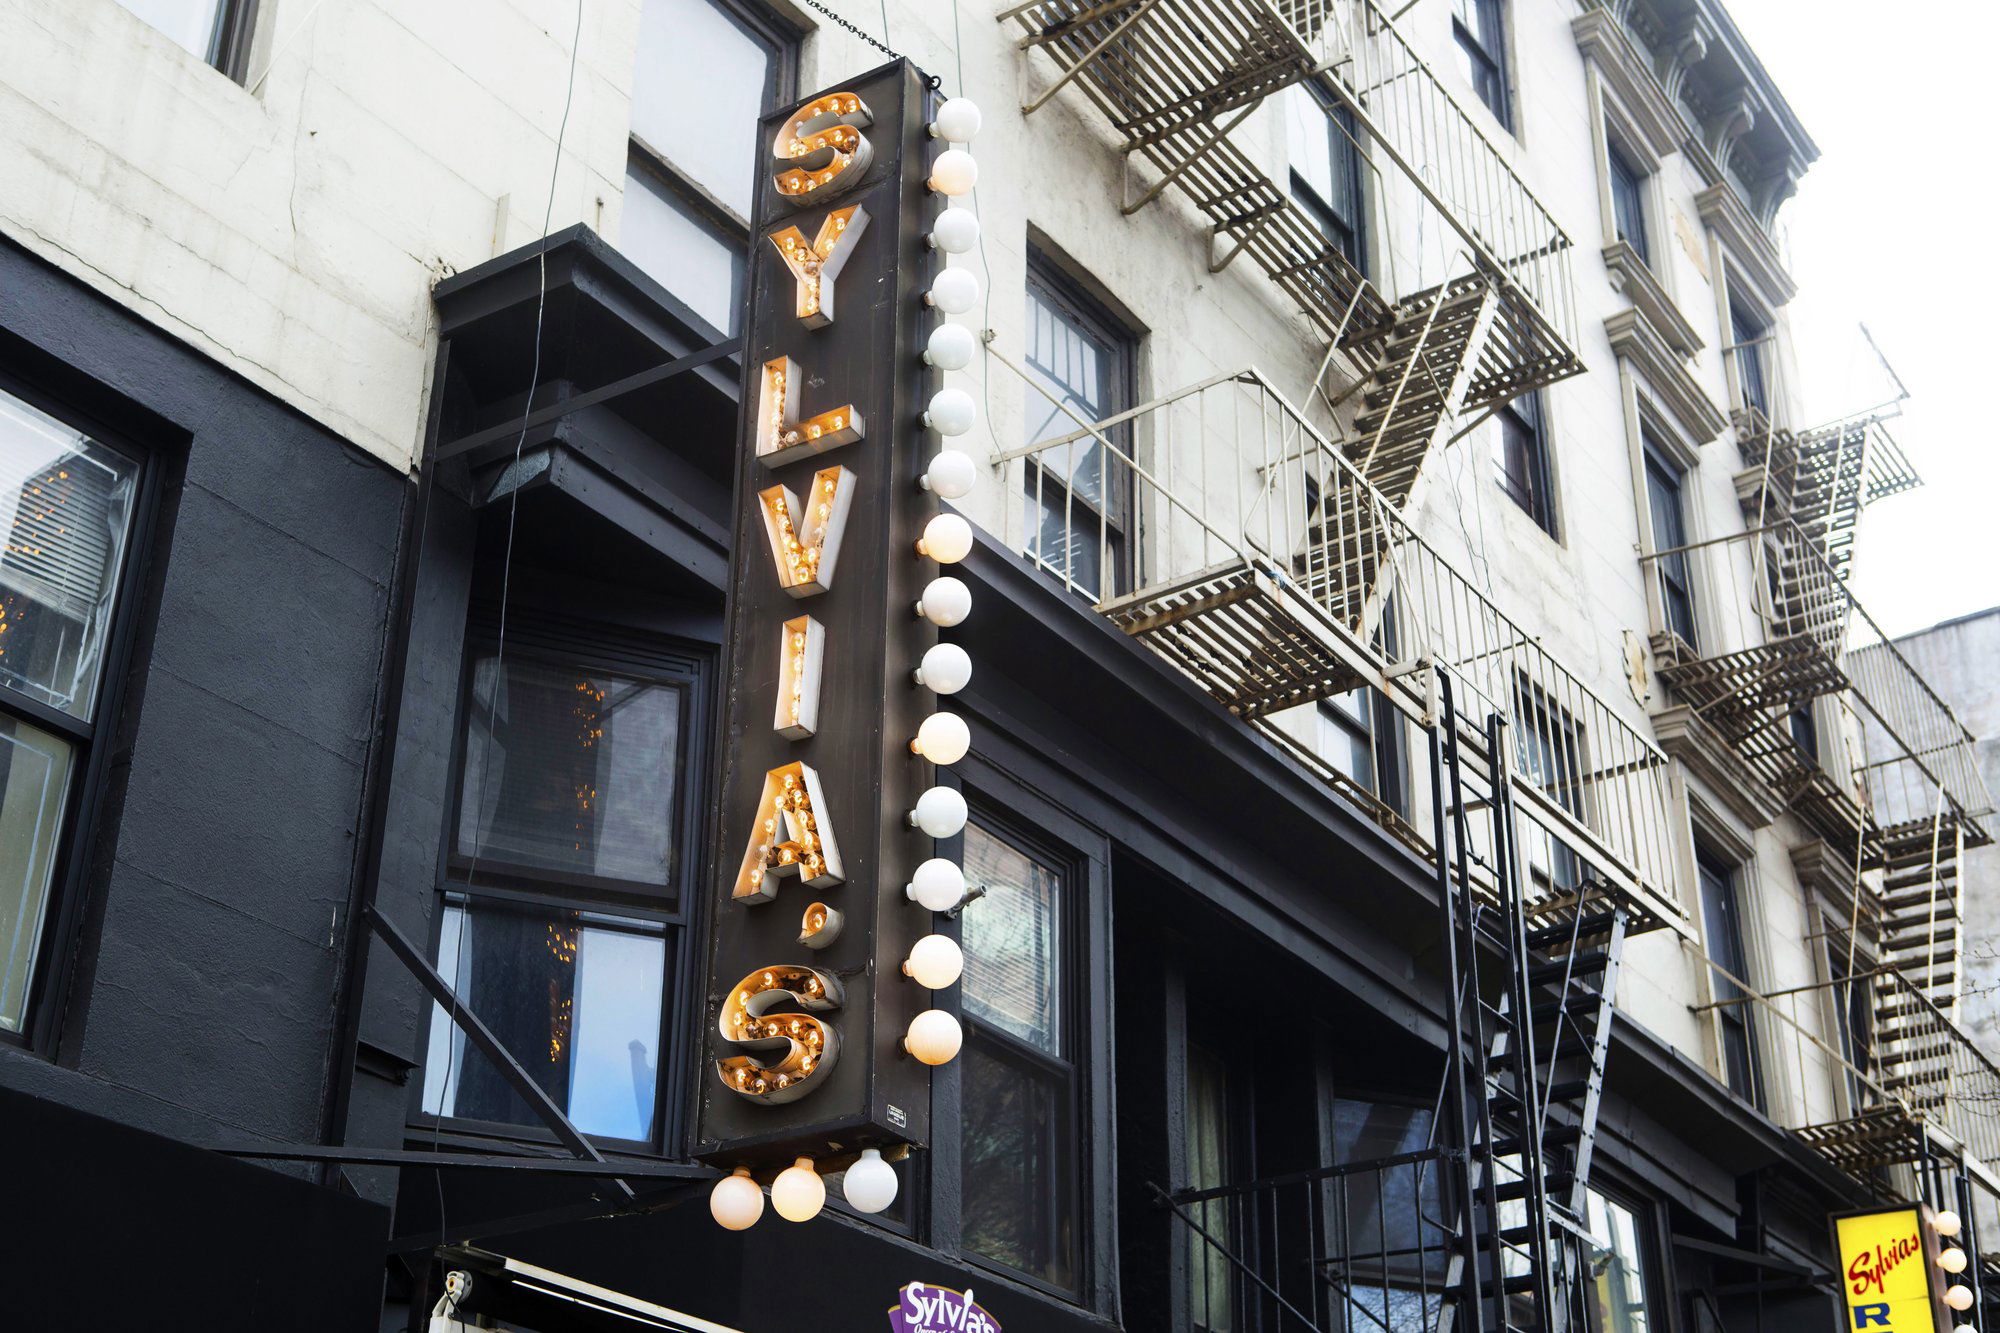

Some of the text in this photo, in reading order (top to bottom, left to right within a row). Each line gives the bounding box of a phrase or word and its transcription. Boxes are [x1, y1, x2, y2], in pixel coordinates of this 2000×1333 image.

[716, 91, 874, 1106] SYLVIA'S
[1848, 1233, 1919, 1295] Sylvias
[1853, 1302, 1894, 1333] R
